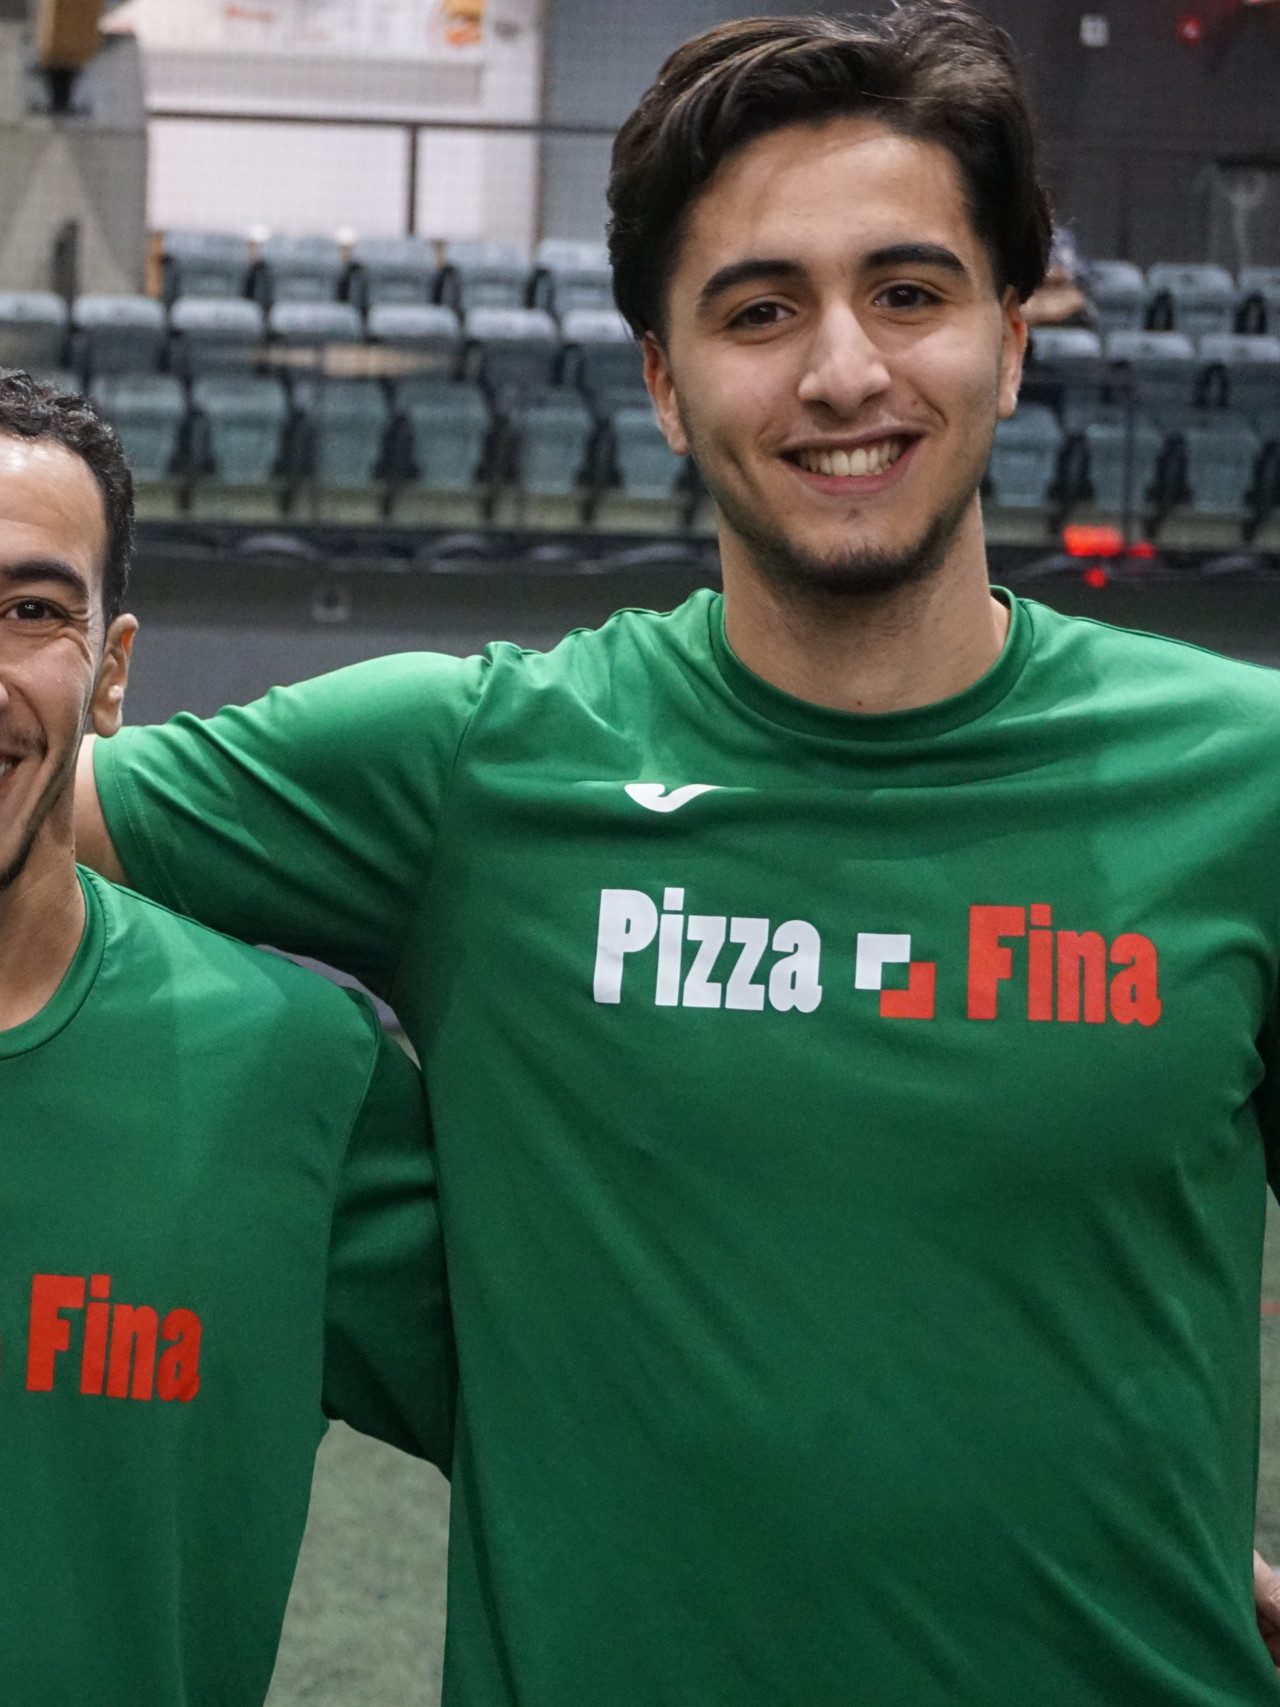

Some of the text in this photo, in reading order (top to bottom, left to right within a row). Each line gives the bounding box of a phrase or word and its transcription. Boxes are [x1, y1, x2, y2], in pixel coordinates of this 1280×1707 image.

[593, 886, 1162, 1027] Pizza Fina
[26, 1273, 202, 1403] Fina
